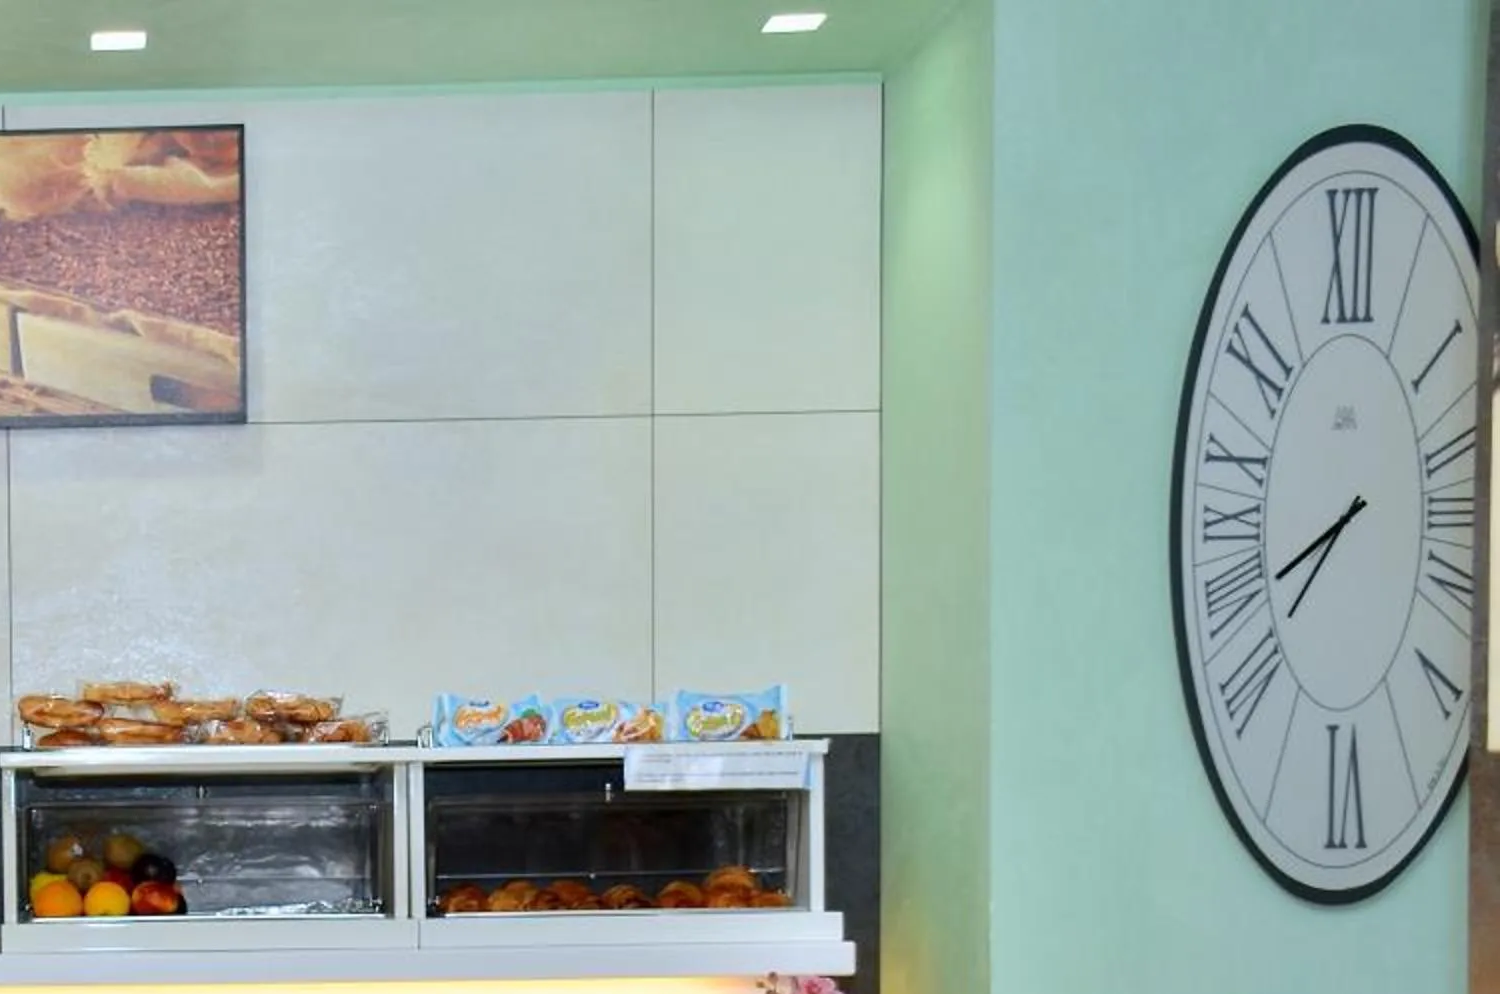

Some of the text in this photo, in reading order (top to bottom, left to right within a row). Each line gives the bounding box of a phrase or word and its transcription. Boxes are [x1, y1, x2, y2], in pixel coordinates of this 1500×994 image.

[1321, 187, 1379, 324] XII
[1225, 304, 1294, 418] XI
[1411, 320, 1462, 394] I
[1205, 434, 1268, 487] X
[1203, 503, 1261, 543] IX
[1204, 550, 1266, 639] VIII
[1218, 628, 1284, 740] VII
[1414, 647, 1463, 720] V
[1323, 723, 1368, 850] VI
